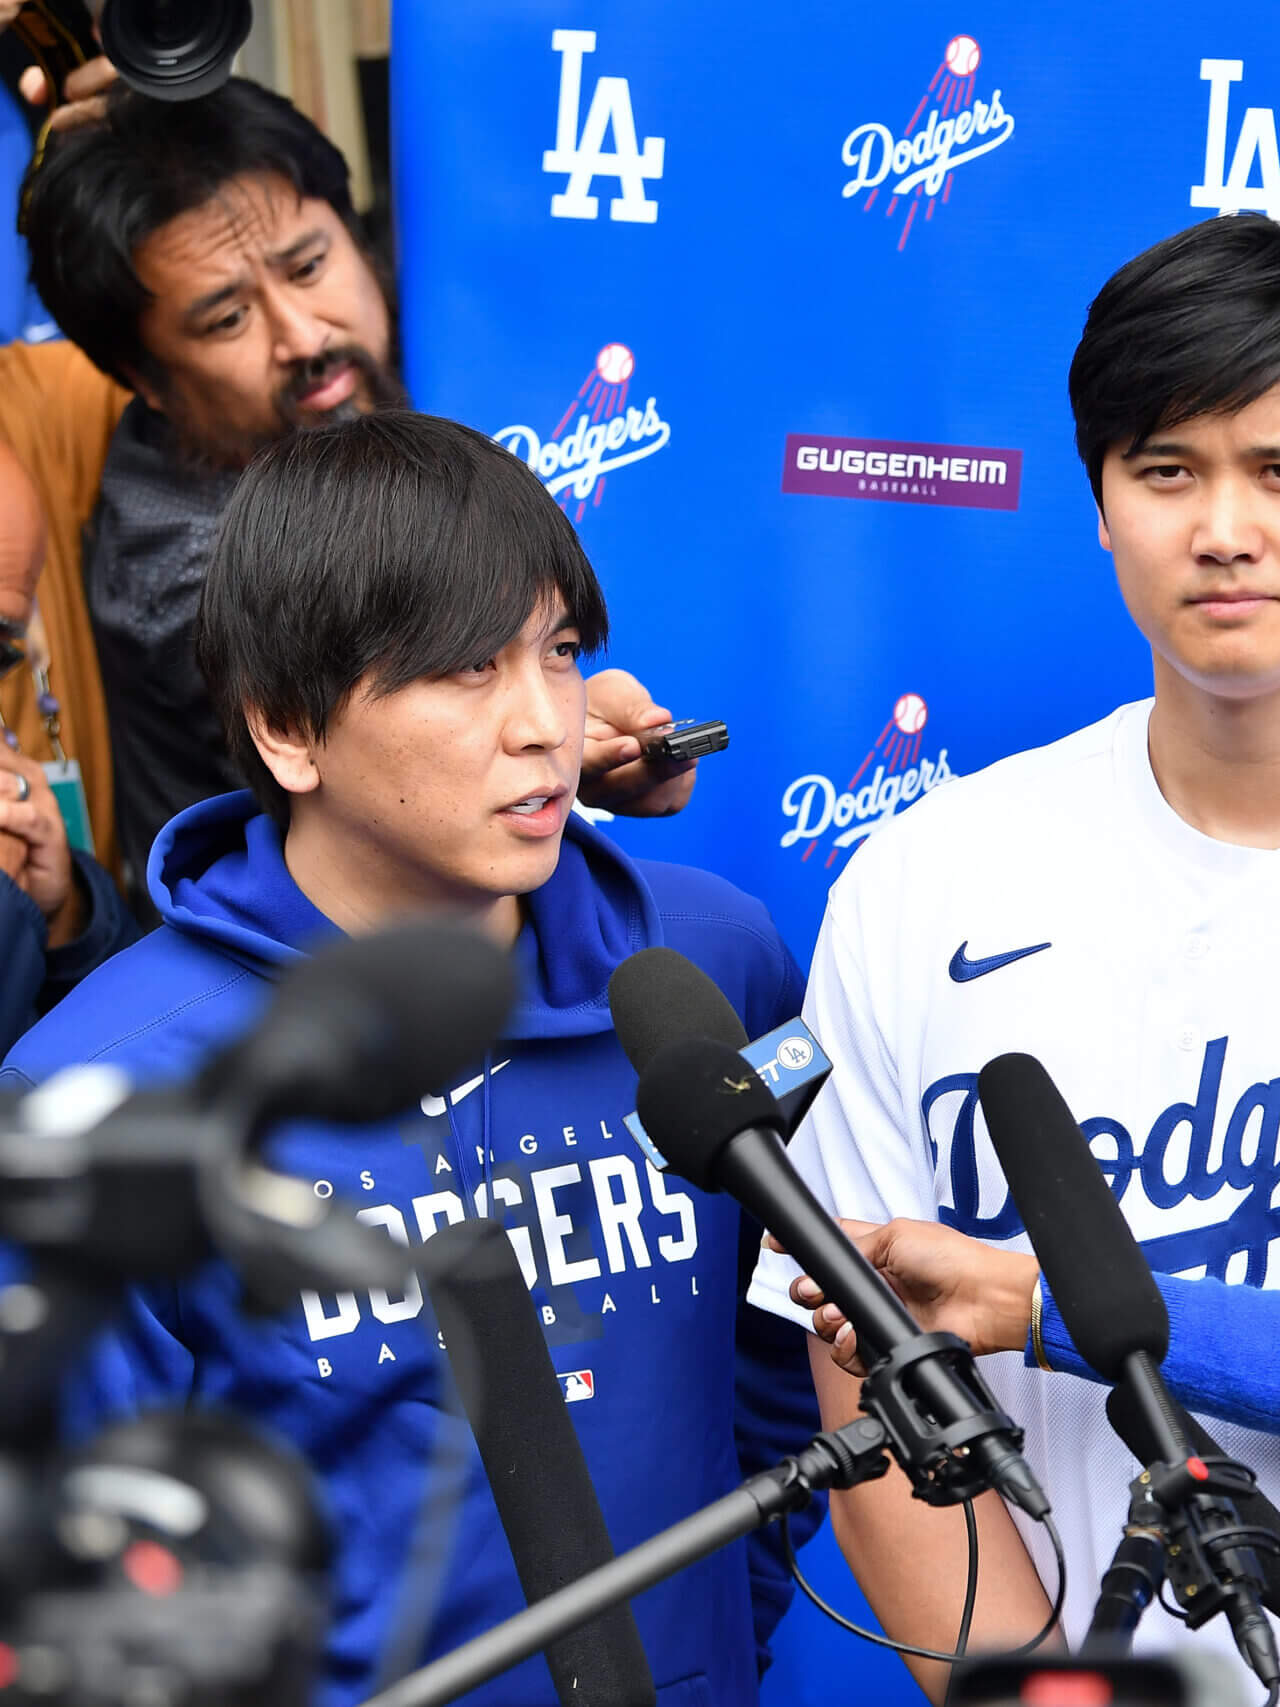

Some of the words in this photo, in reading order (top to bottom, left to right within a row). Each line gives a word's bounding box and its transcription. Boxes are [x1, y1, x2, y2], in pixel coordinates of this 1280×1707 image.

[543, 29, 665, 223] LA
[842, 89, 1014, 197] Dodgers
[796, 446, 1007, 485] GUGGENHEIM
[858, 479, 937, 496] BASEBALL
[313, 1171, 375, 1200] OS
[434, 1120, 614, 1175] ANGEL
